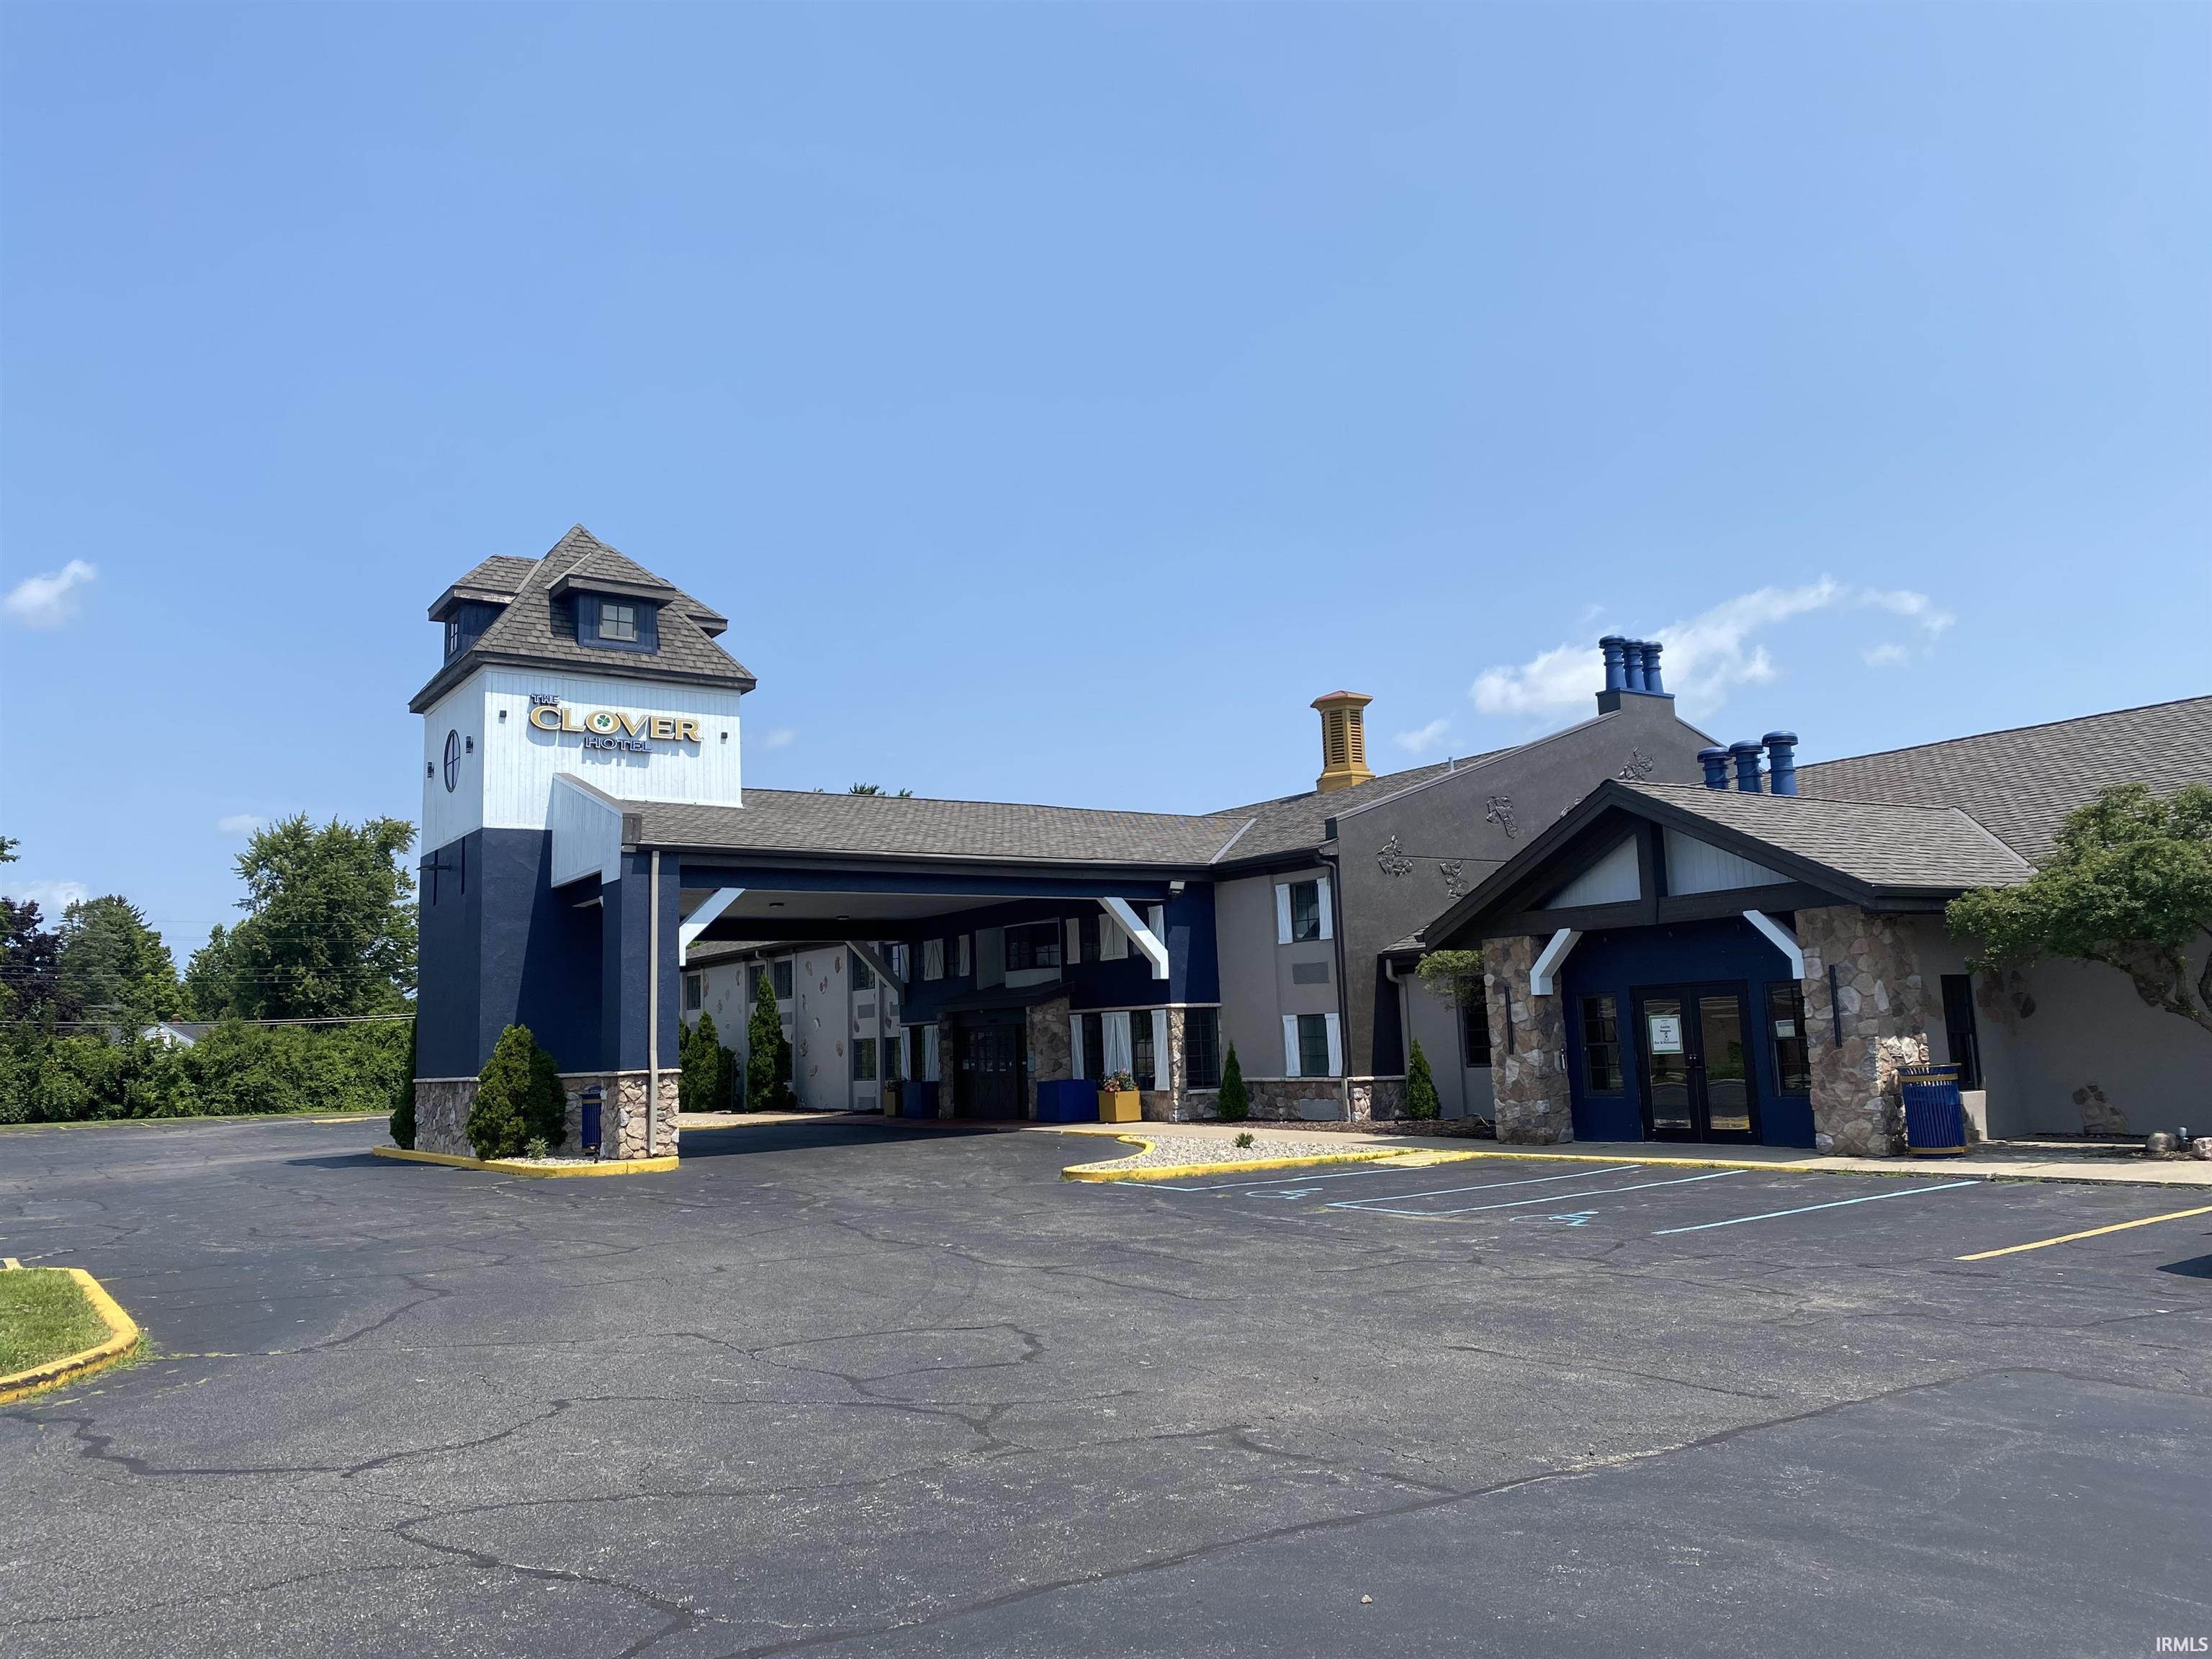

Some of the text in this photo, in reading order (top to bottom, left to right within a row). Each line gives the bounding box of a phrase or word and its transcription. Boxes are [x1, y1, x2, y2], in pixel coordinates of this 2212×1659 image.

[530, 693, 560, 705] THE
[530, 705, 703, 742] CLOVER
[585, 737, 653, 752] HOTEL
